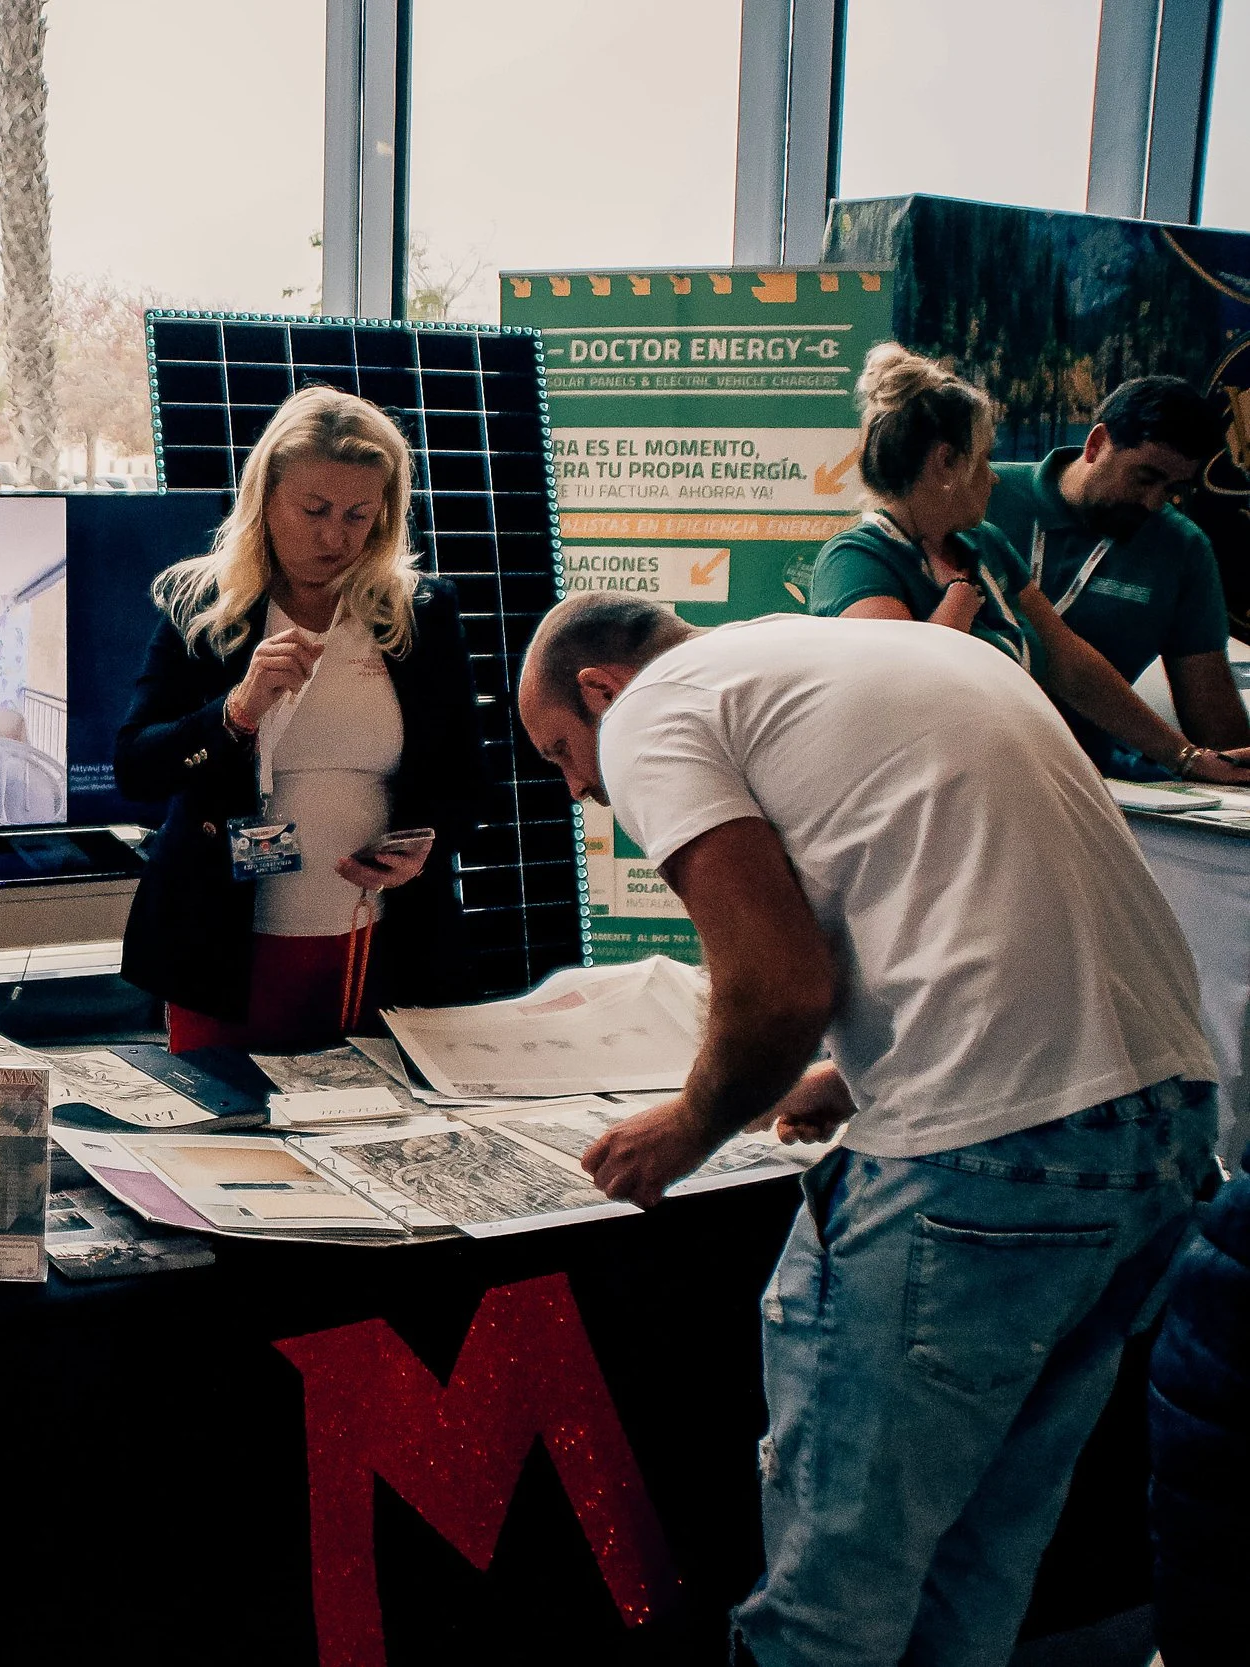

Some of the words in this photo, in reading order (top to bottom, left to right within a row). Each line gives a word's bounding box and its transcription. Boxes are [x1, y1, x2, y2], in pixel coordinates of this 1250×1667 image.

[570, 338, 681, 362] DOCTOR
[690, 337, 802, 361] ENERGY
[590, 376, 636, 387] PANELS
[641, 376, 651, 387] &
[656, 375, 712, 387] ELECTRIC
[716, 375, 768, 387] VEHICLE
[772, 374, 839, 387] CHARGERS
[553, 439, 579, 456] RA
[586, 439, 610, 457] ES
[616, 439, 638, 457] EL
[644, 438, 760, 460] MOMENTO,
[596, 461, 622, 479] TU
[628, 461, 704, 479] PROPIA
[710, 457, 808, 481] ENERGÍA.
[575, 484, 595, 499] TU
[678, 484, 746, 500] AHORRA
[751, 485, 774, 501] YA!
[636, 518, 660, 535] EN
[665, 518, 759, 536] EFICIENCIA
[627, 883, 668, 894] SOLAR
